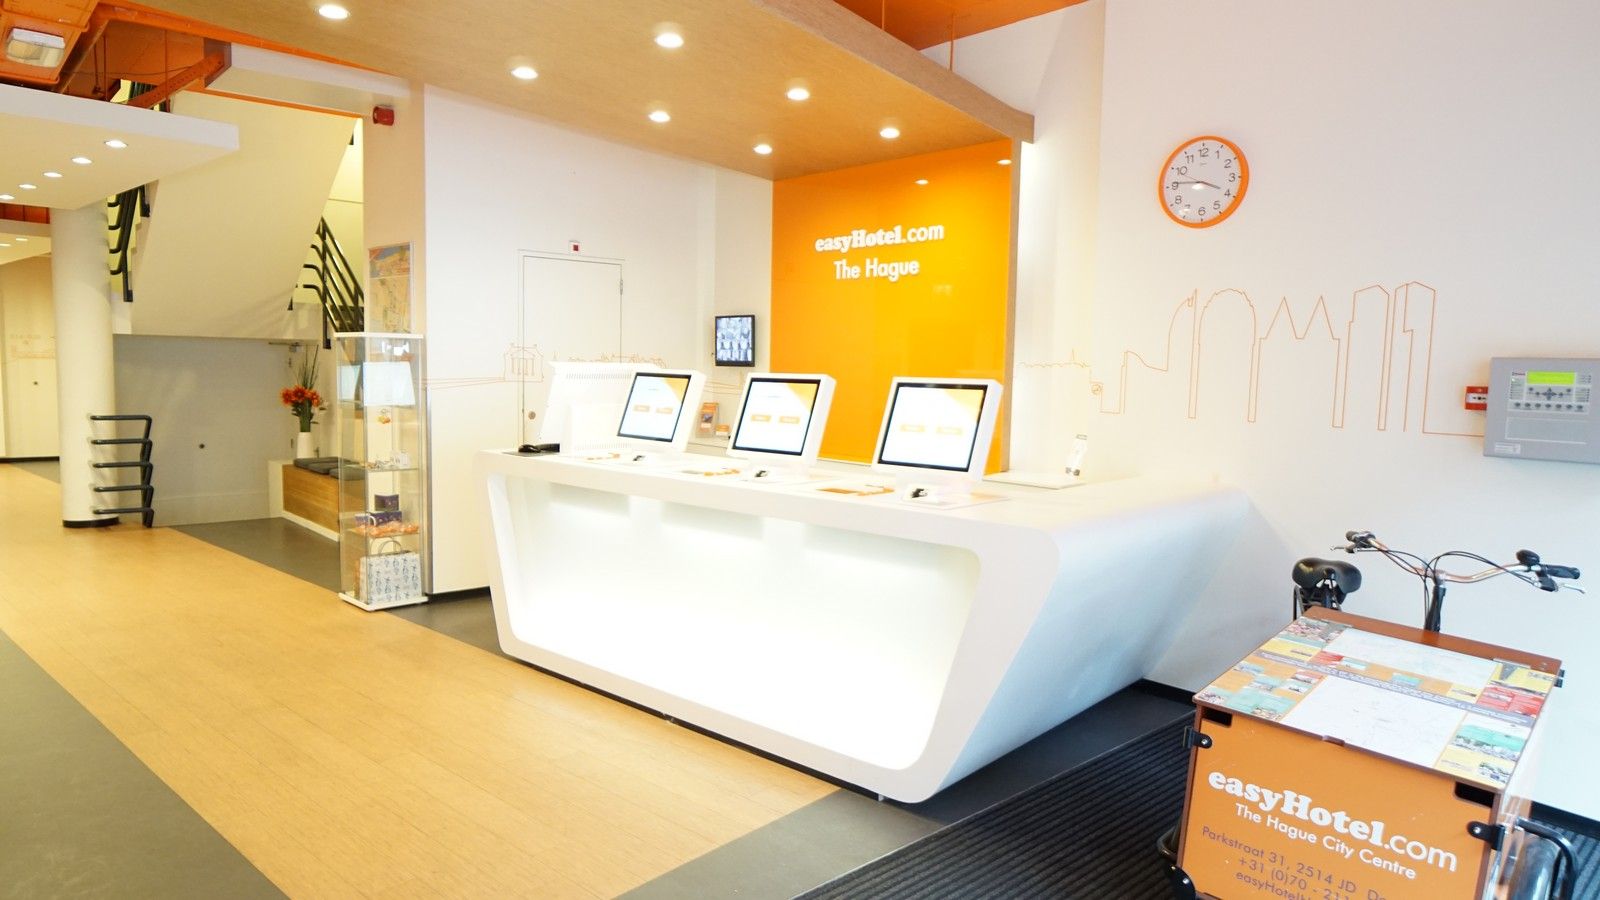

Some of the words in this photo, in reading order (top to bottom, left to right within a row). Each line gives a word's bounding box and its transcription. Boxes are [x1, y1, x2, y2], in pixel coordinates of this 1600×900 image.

[1198, 148, 1209, 157] 12
[1215, 150, 1220, 159] 1
[1185, 154, 1194, 164] 11
[1224, 159, 1232, 169] 2
[1176, 166, 1188, 176] 10
[1228, 173, 1236, 182] 3
[1171, 181, 1179, 190] 9
[1224, 189, 1231, 197] 4
[1175, 195, 1182, 204] 8
[1213, 200, 1221, 210] 5
[1198, 206, 1206, 216] 6
[815, 225, 944, 253] easyHotel.com
[833, 259, 861, 280] The
[865, 257, 919, 282] Hague
[1208, 771, 1457, 872] easyHotel.com
[1235, 802, 1262, 823] The
[1266, 814, 1317, 844] Hague
[1322, 835, 1355, 859] City
[1359, 848, 1416, 879] Centre
[1202, 825, 1265, 858] Parkstraat
[1268, 851, 1290, 871] 31,
[1297, 862, 1333, 884] 2514
[1338, 879, 1357, 893] JD
[1239, 857, 1265, 873] +31
[1271, 868, 1307, 890] (0)70
